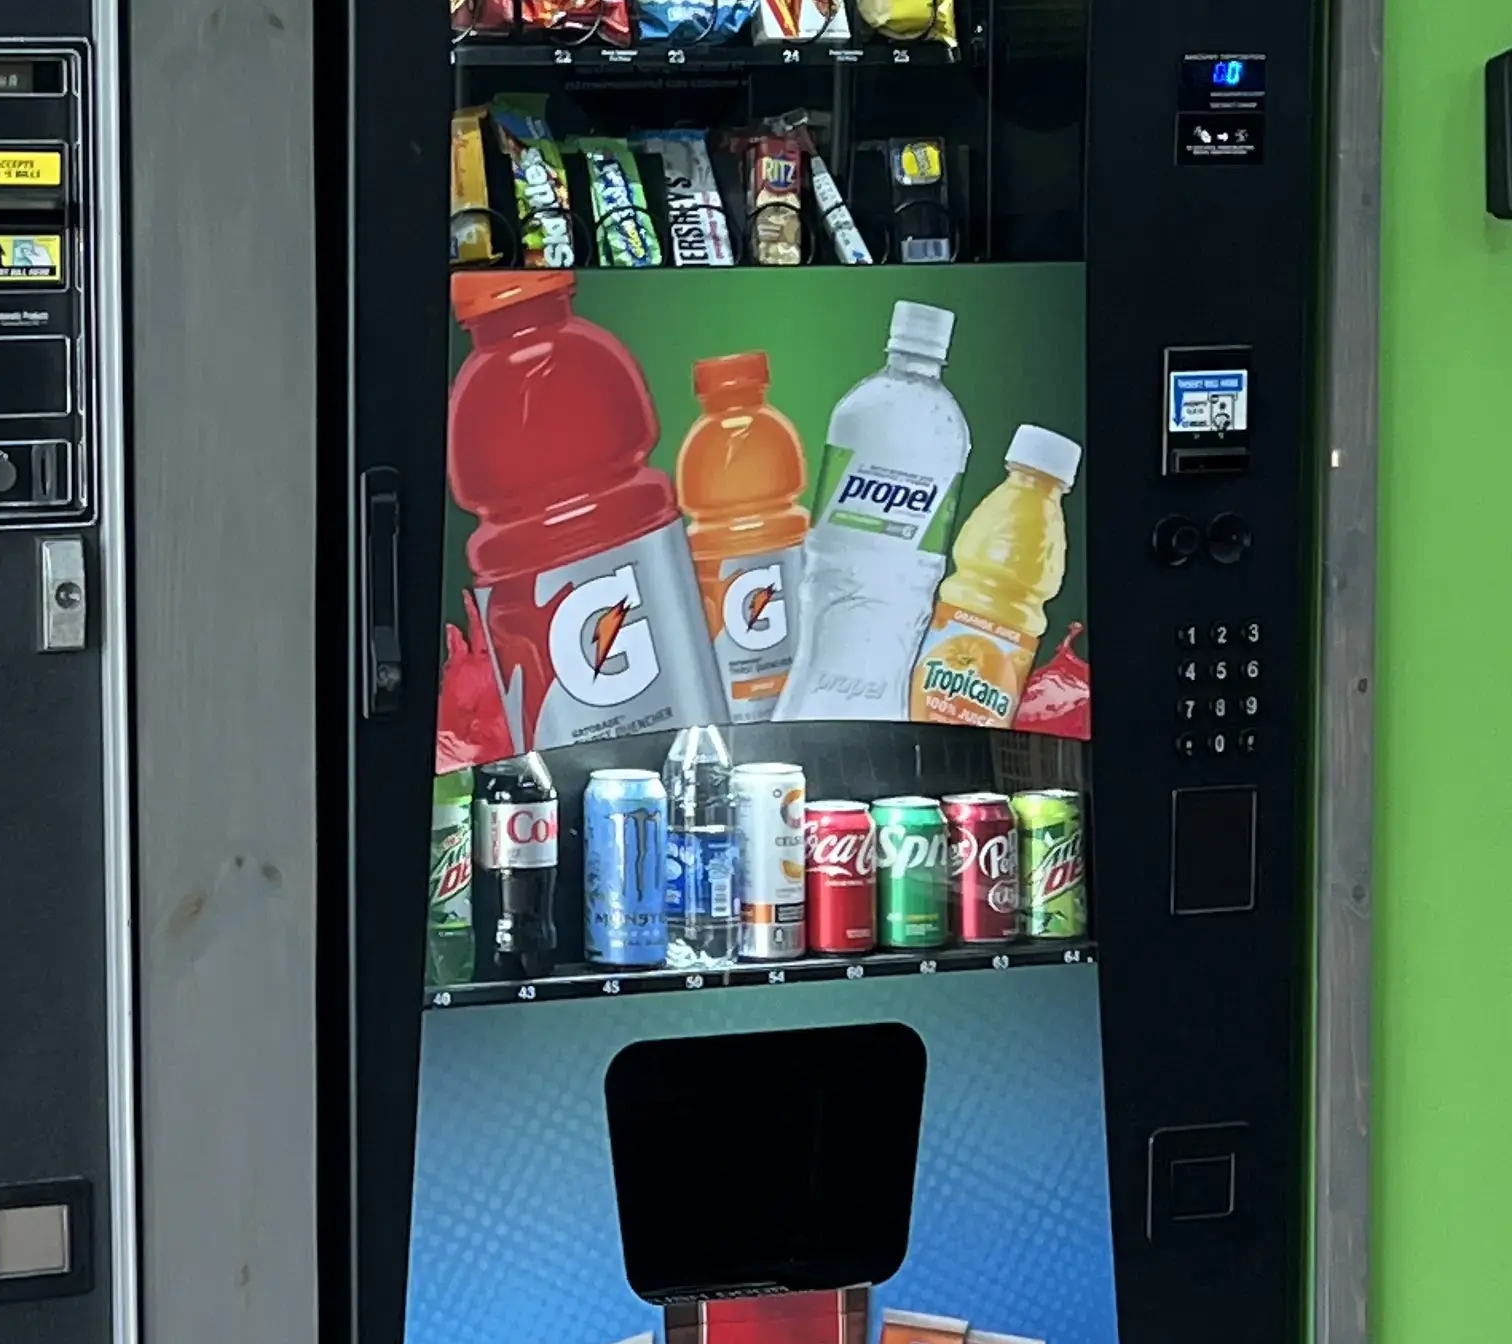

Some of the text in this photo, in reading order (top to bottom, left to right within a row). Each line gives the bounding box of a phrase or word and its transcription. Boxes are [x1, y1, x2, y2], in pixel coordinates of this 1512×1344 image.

[762, 156, 796, 185] RITZ
[838, 475, 938, 513] propel
[723, 564, 788, 651] G
[549, 563, 661, 707] G
[1217, 626, 1227, 644] 2
[1248, 623, 1259, 642] 3
[1216, 660, 1259, 679] 5 6
[924, 660, 1009, 717] Tropicana
[1246, 696, 1257, 715] 9
